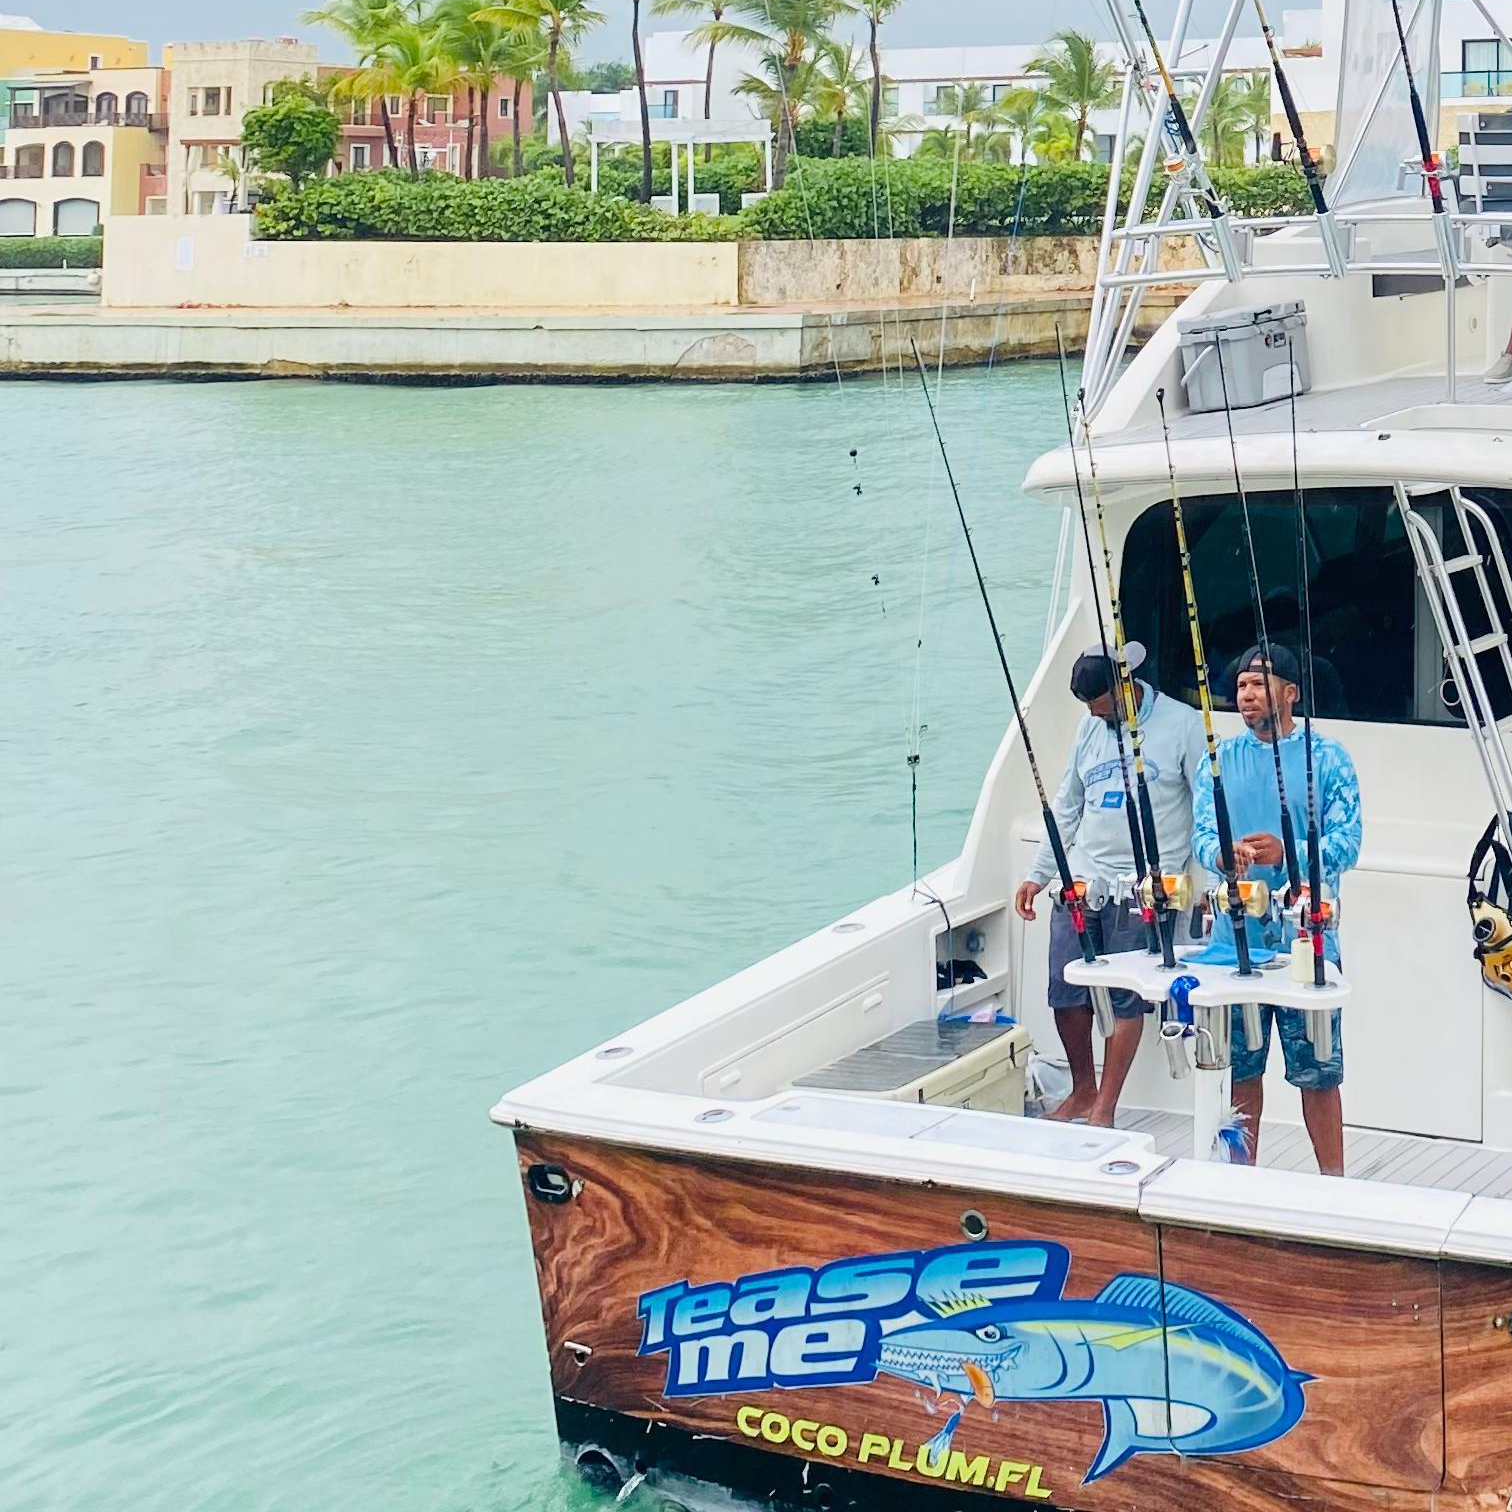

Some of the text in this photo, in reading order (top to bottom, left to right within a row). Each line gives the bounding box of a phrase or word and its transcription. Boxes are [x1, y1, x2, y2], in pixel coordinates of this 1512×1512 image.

[641, 1247, 1048, 1345] Tease
[679, 1318, 867, 1385] me
[736, 1405, 1054, 1499] COCO PLUM.FL
